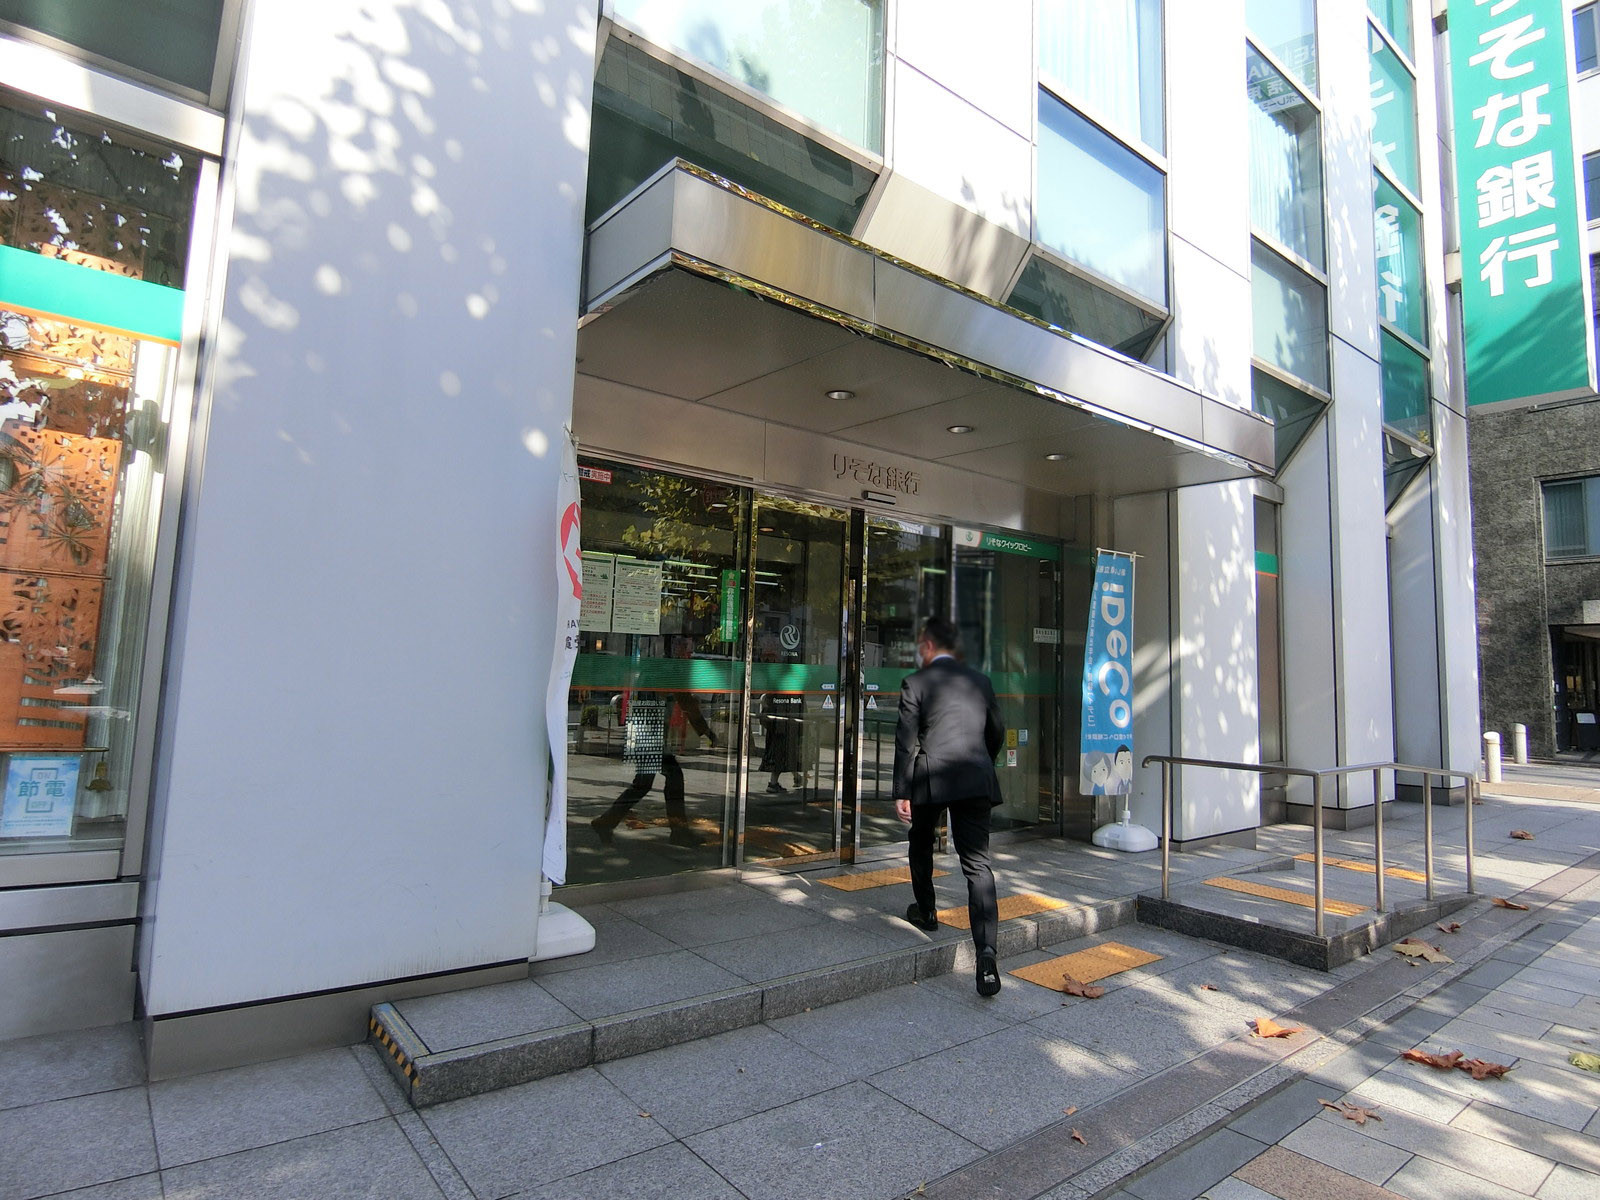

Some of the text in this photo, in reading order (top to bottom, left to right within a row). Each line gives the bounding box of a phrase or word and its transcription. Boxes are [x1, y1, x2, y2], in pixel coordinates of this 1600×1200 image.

[1468, 0, 1560, 297] そな銀行
[833, 453, 921, 495] りそな銀行
[986, 537, 1032, 552] りそなクイックロビー
[18, 780, 66, 798] 節電
